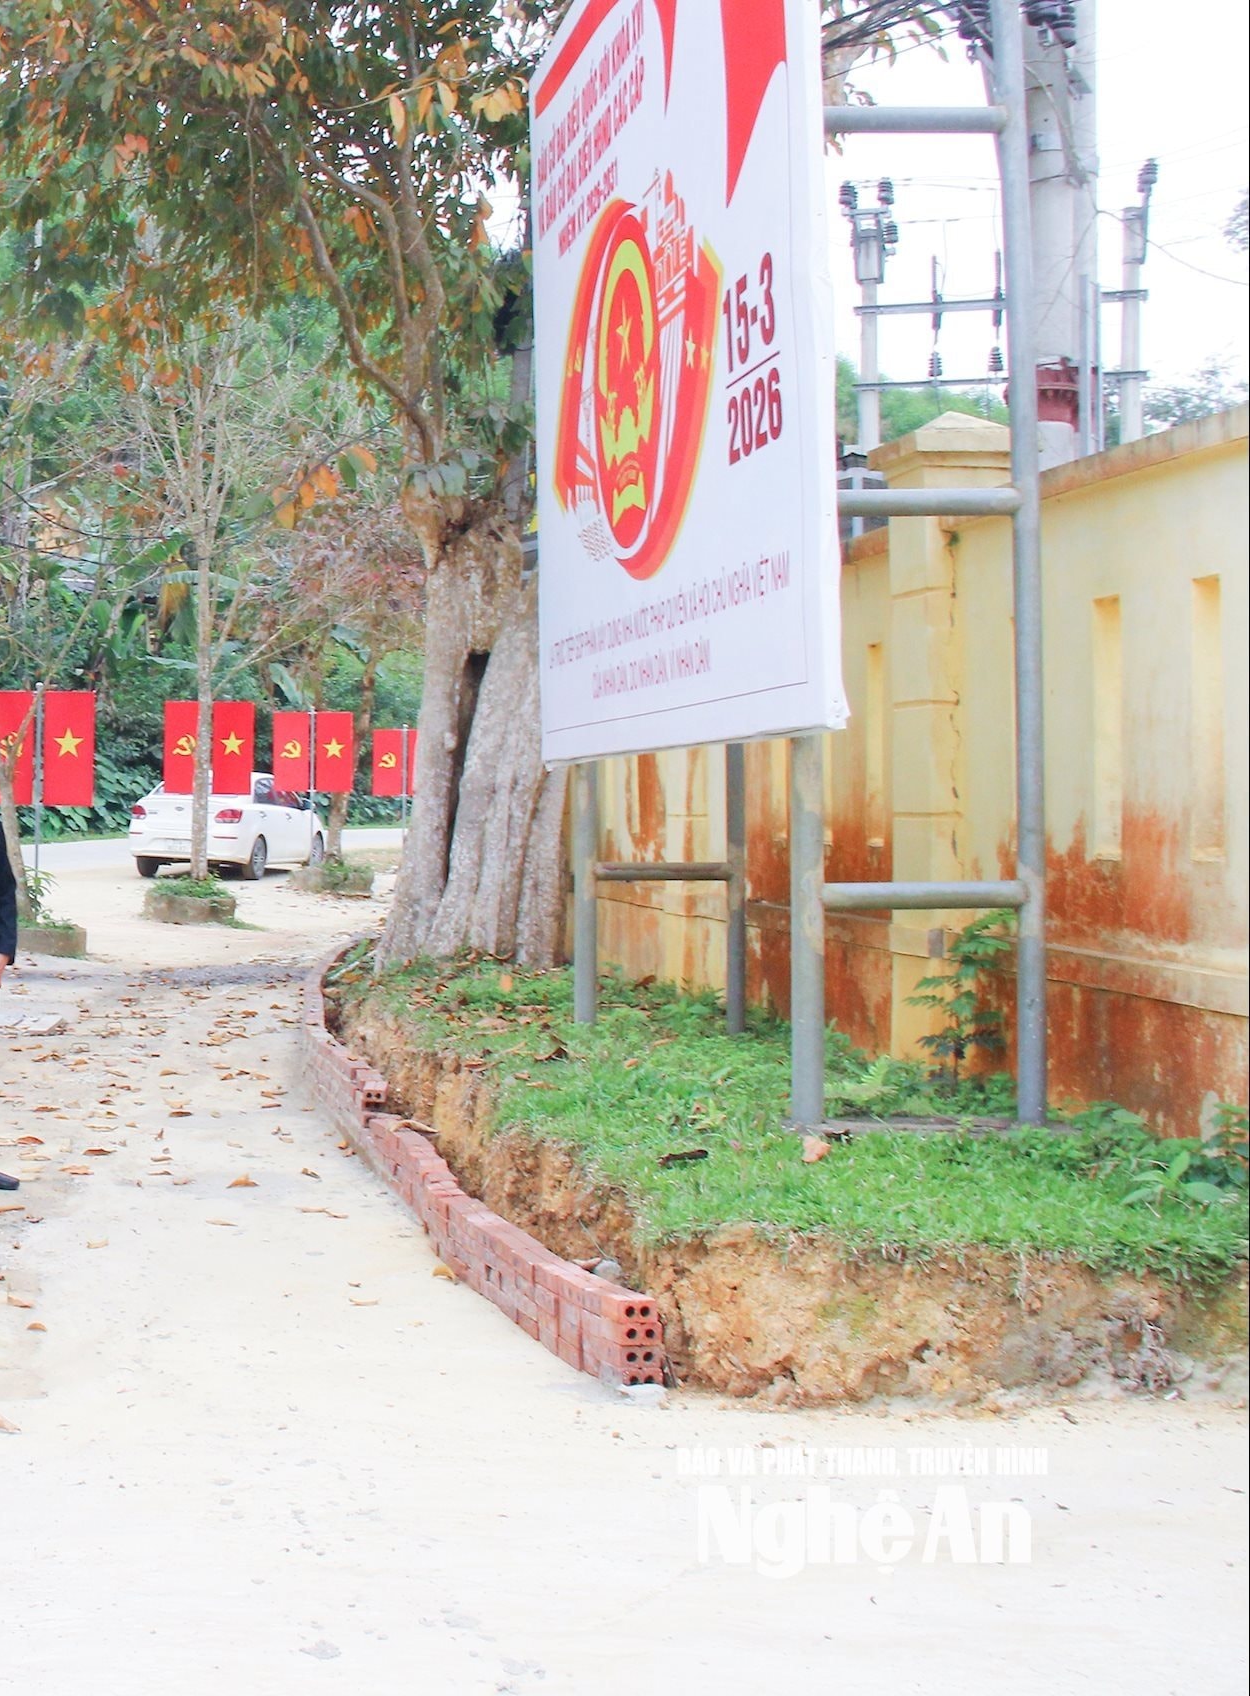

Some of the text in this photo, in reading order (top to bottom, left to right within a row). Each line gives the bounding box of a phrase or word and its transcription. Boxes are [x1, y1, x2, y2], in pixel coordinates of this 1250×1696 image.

[613, 76, 628, 137] CÁC
[629, 45, 644, 114] CẤP
[723, 252, 775, 374] 15-3
[727, 367, 783, 466] 2026
[770, 548, 791, 592] NAM
